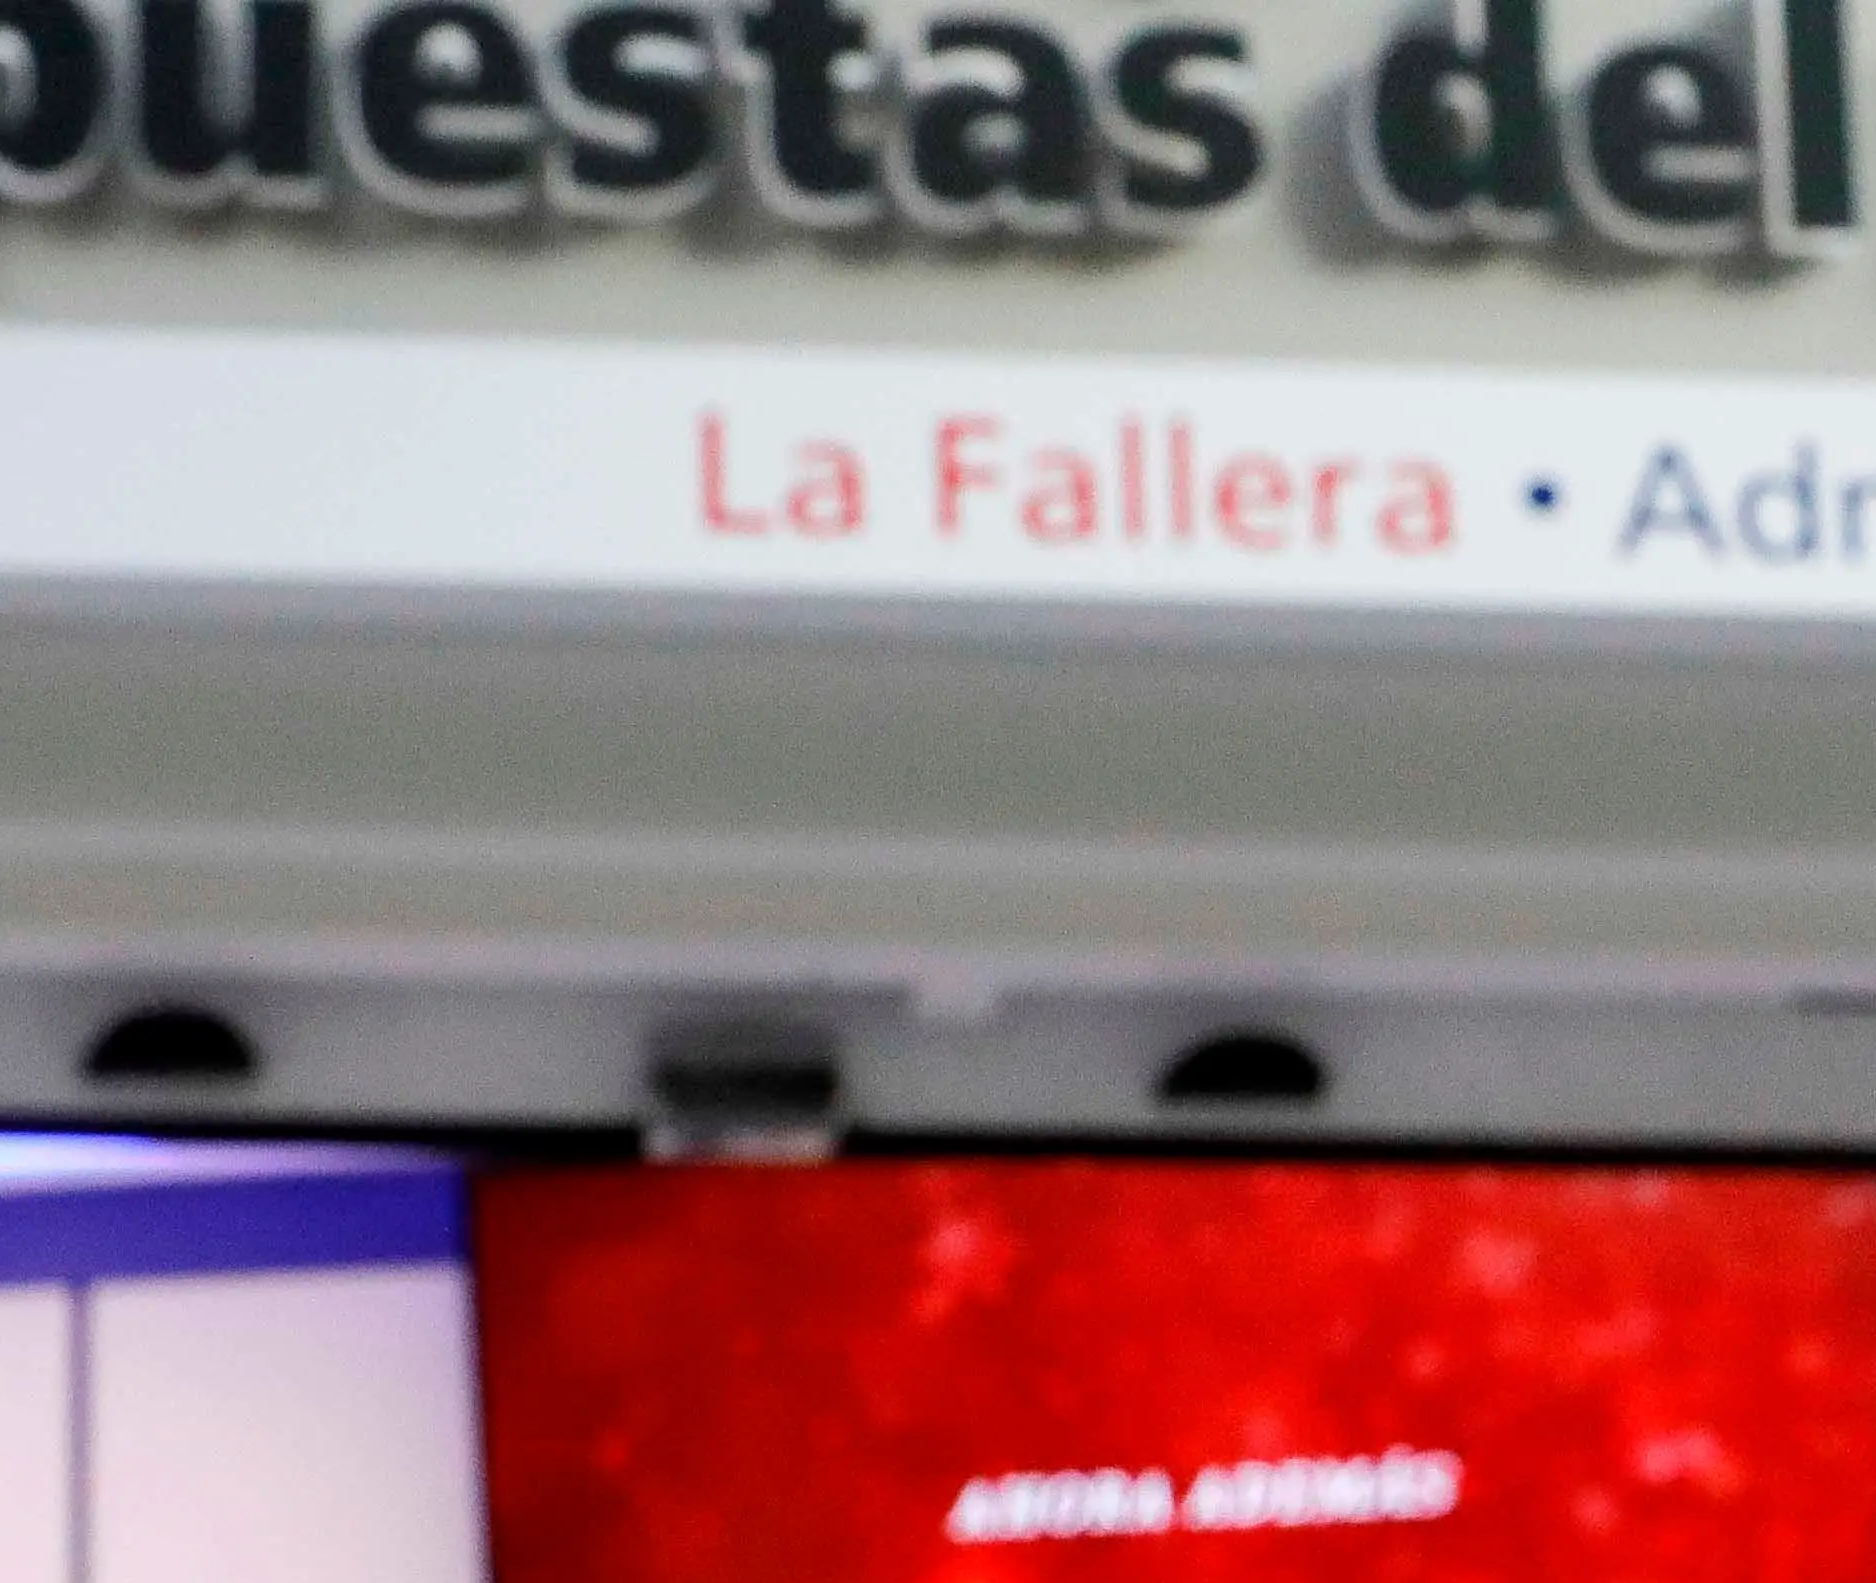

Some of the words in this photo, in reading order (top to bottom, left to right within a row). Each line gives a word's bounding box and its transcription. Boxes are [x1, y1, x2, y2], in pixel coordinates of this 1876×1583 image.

[1362, 0, 1860, 245] del
[697, 411, 868, 541] La
[934, 412, 1459, 556] Fallera
